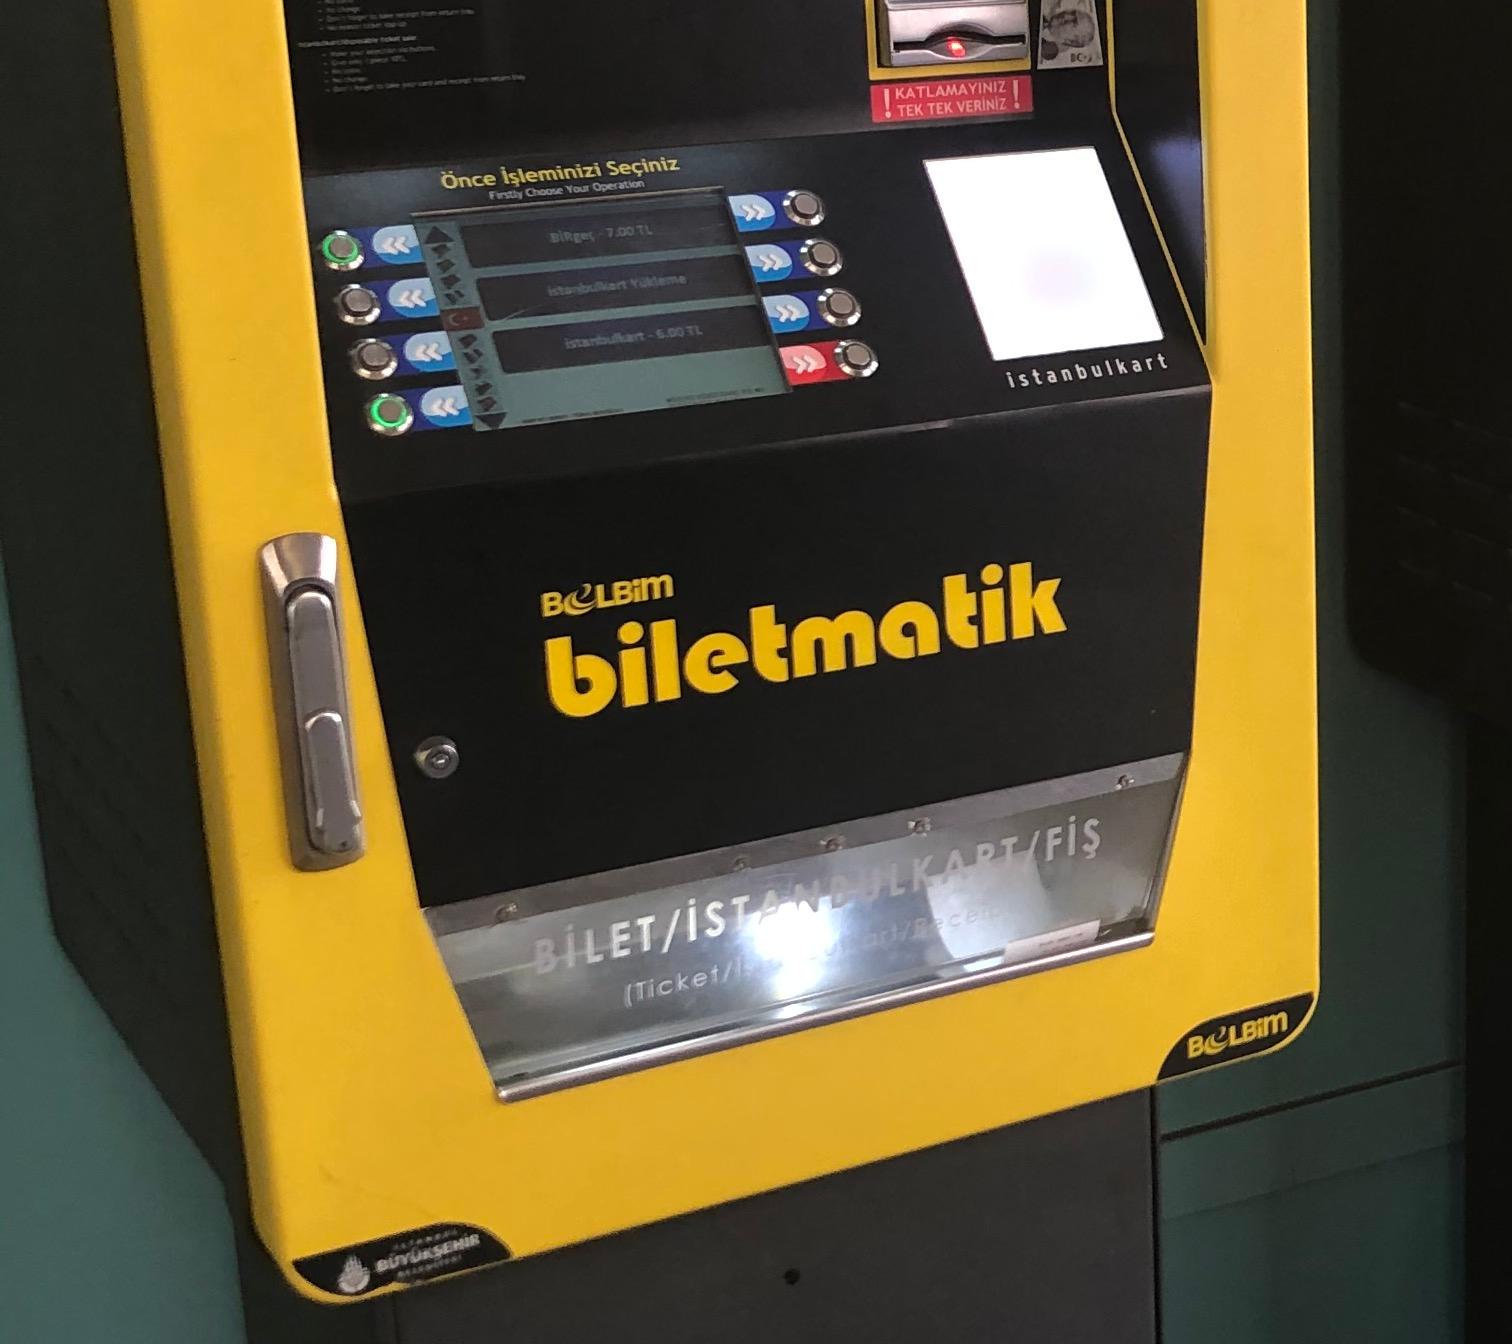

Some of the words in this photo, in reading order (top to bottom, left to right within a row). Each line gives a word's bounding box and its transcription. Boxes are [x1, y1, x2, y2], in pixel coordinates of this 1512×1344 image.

[895, 80, 1007, 100] KATLAMAYINIZ
[897, 104, 924, 118] TEK
[926, 102, 952, 116] TEK
[956, 98, 1007, 114] VERİNİZ
[440, 171, 497, 190] Önce
[500, 163, 603, 188] İşleminizi
[607, 156, 681, 178] Seçiniz
[489, 190, 523, 201] Firstly
[525, 186, 564, 198] Choose
[566, 184, 590, 195] Your
[592, 178, 646, 192] Operation
[635, 224, 653, 236] TL
[685, 325, 703, 337] TL
[1005, 352, 1168, 389] istanbulkart
[544, 561, 1068, 718] biletmatik
